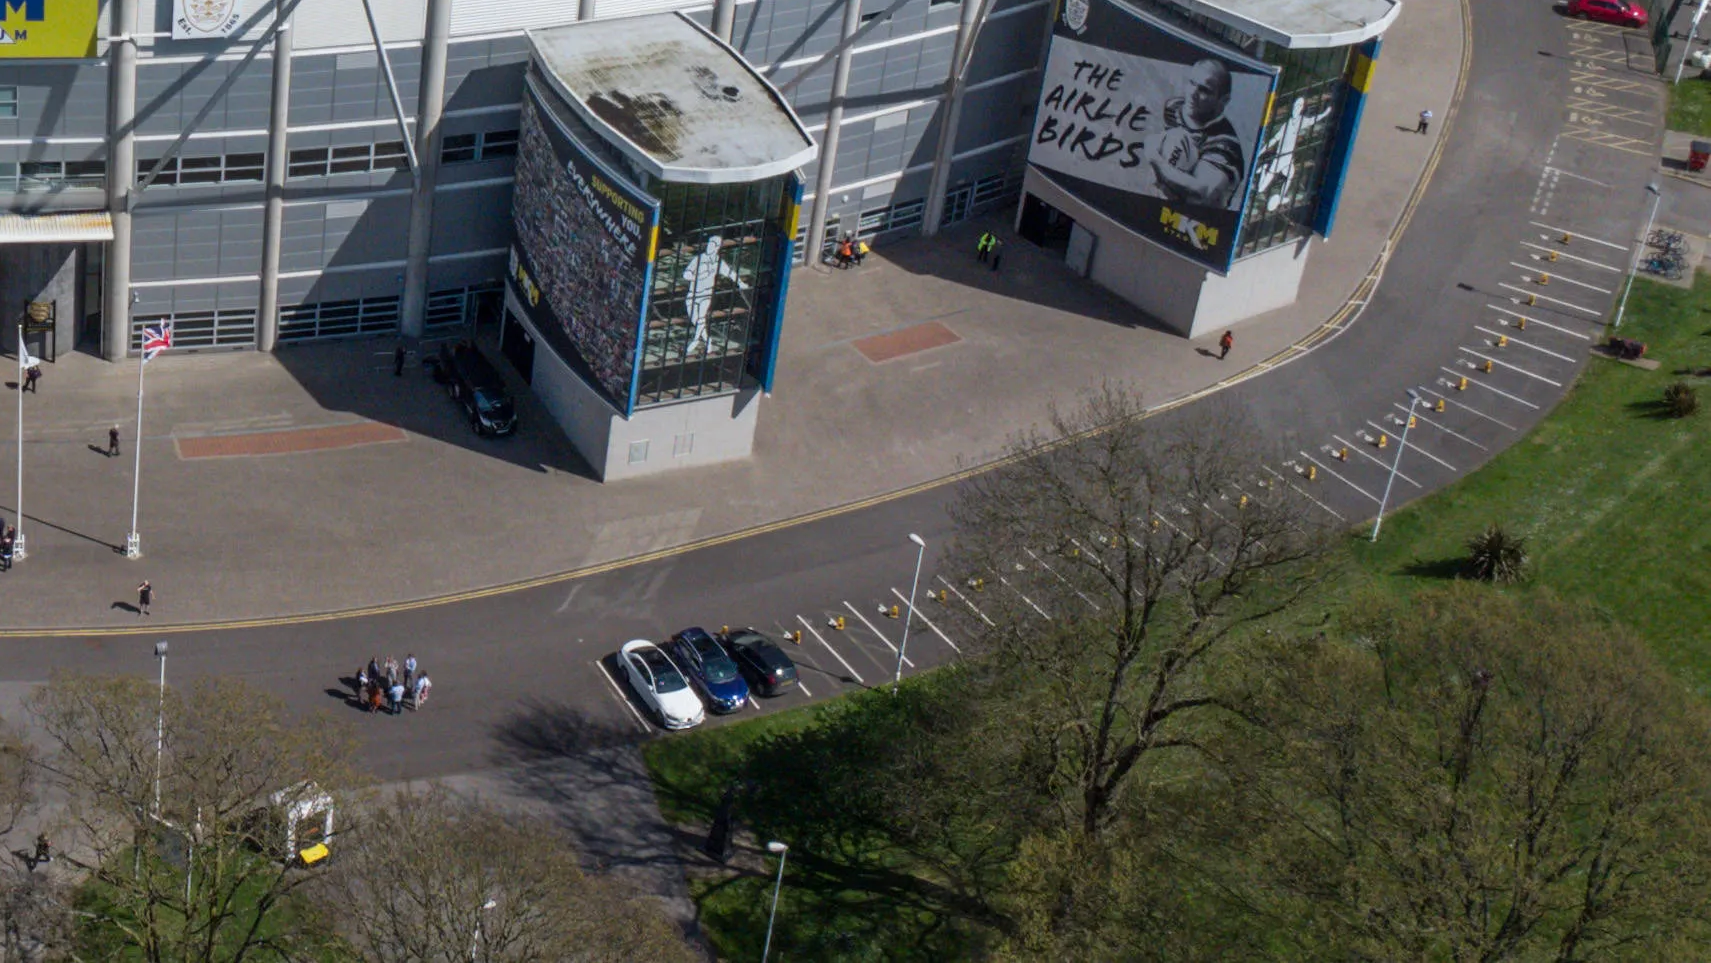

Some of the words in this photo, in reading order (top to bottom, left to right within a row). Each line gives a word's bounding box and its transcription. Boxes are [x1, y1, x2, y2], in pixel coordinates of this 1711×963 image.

[1074, 59, 1125, 91] THE
[1044, 84, 1152, 131] AIRLIE
[1037, 115, 1145, 168] BIRDS
[591, 174, 644, 225] SUPPORTING
[1160, 206, 1218, 249] MKM
